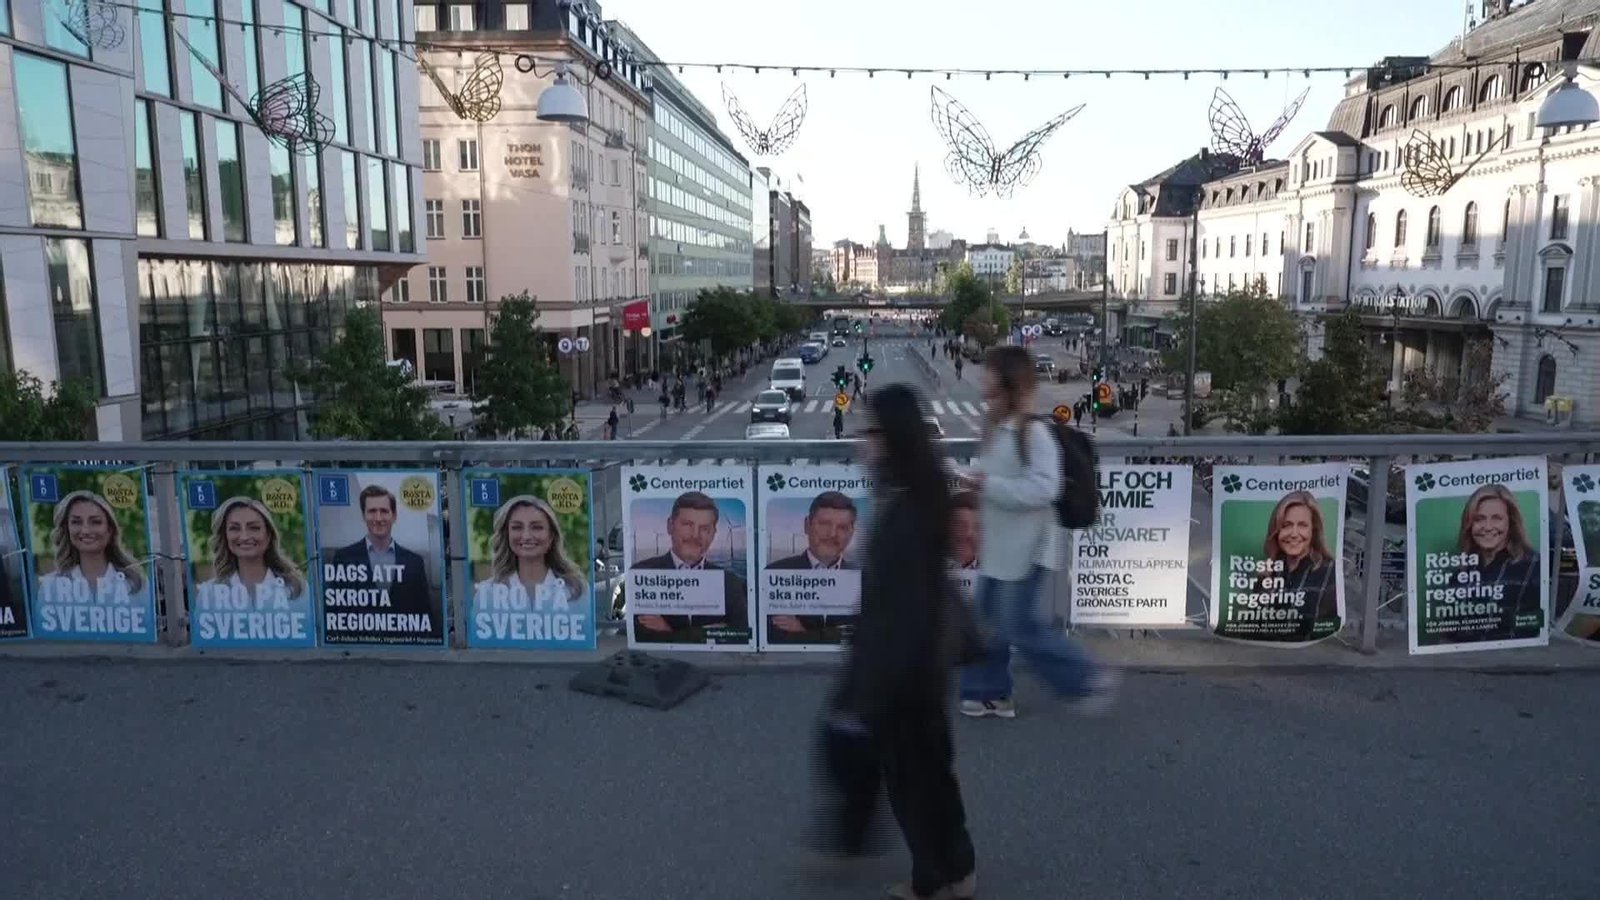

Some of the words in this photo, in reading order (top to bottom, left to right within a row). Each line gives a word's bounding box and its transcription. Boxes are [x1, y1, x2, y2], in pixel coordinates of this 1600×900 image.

[507, 143, 541, 153] THON
[504, 156, 545, 166] HOTEL
[509, 169, 541, 179] VASA
[650, 476, 745, 492] Centerpartiet
[1096, 470, 1123, 489] LF
[1125, 470, 1173, 490] OCH
[1245, 473, 1341, 492] Centerpartiet
[1438, 467, 1540, 487] Centerpartiet
[1096, 490, 1155, 509] MMIE
[1079, 527, 1171, 542] ANSVARET
[1078, 541, 1109, 558] FÖR
[1229, 554, 1285, 573] Rösta
[1425, 552, 1480, 569] Rösta
[324, 564, 369, 583] DAGS
[372, 564, 405, 583] ATT
[634, 574, 700, 589] Utsläppen
[769, 573, 837, 589] Utsläppen
[1077, 569, 1120, 585] RÖSTA
[1123, 573, 1135, 585] C.
[1228, 571, 1259, 590] för
[1262, 576, 1285, 590] en
[1425, 569, 1453, 586] för
[1457, 569, 1481, 584] en
[38, 575, 90, 604] TRO
[196, 582, 250, 611] TRO
[325, 588, 392, 607] SKROTA
[474, 582, 529, 611] TRO
[634, 589, 658, 601] ska
[660, 590, 685, 601] ner.
[769, 588, 792, 601] ska
[795, 590, 820, 601] ner.
[1077, 586, 1129, 597] SVERIGES
[1228, 588, 1306, 608] regering
[1426, 582, 1504, 603] regering
[1136, 598, 1168, 608] PARTI
[1425, 602, 1431, 618] i
[1435, 601, 1503, 618] mitten.
[41, 605, 147, 634] SVERIGE
[326, 611, 433, 632] REGIONERNA
[1228, 606, 1233, 621] i
[1237, 606, 1304, 621] mitten.
[199, 611, 308, 640] SVERIGE
[475, 611, 588, 641] SVERIGE
